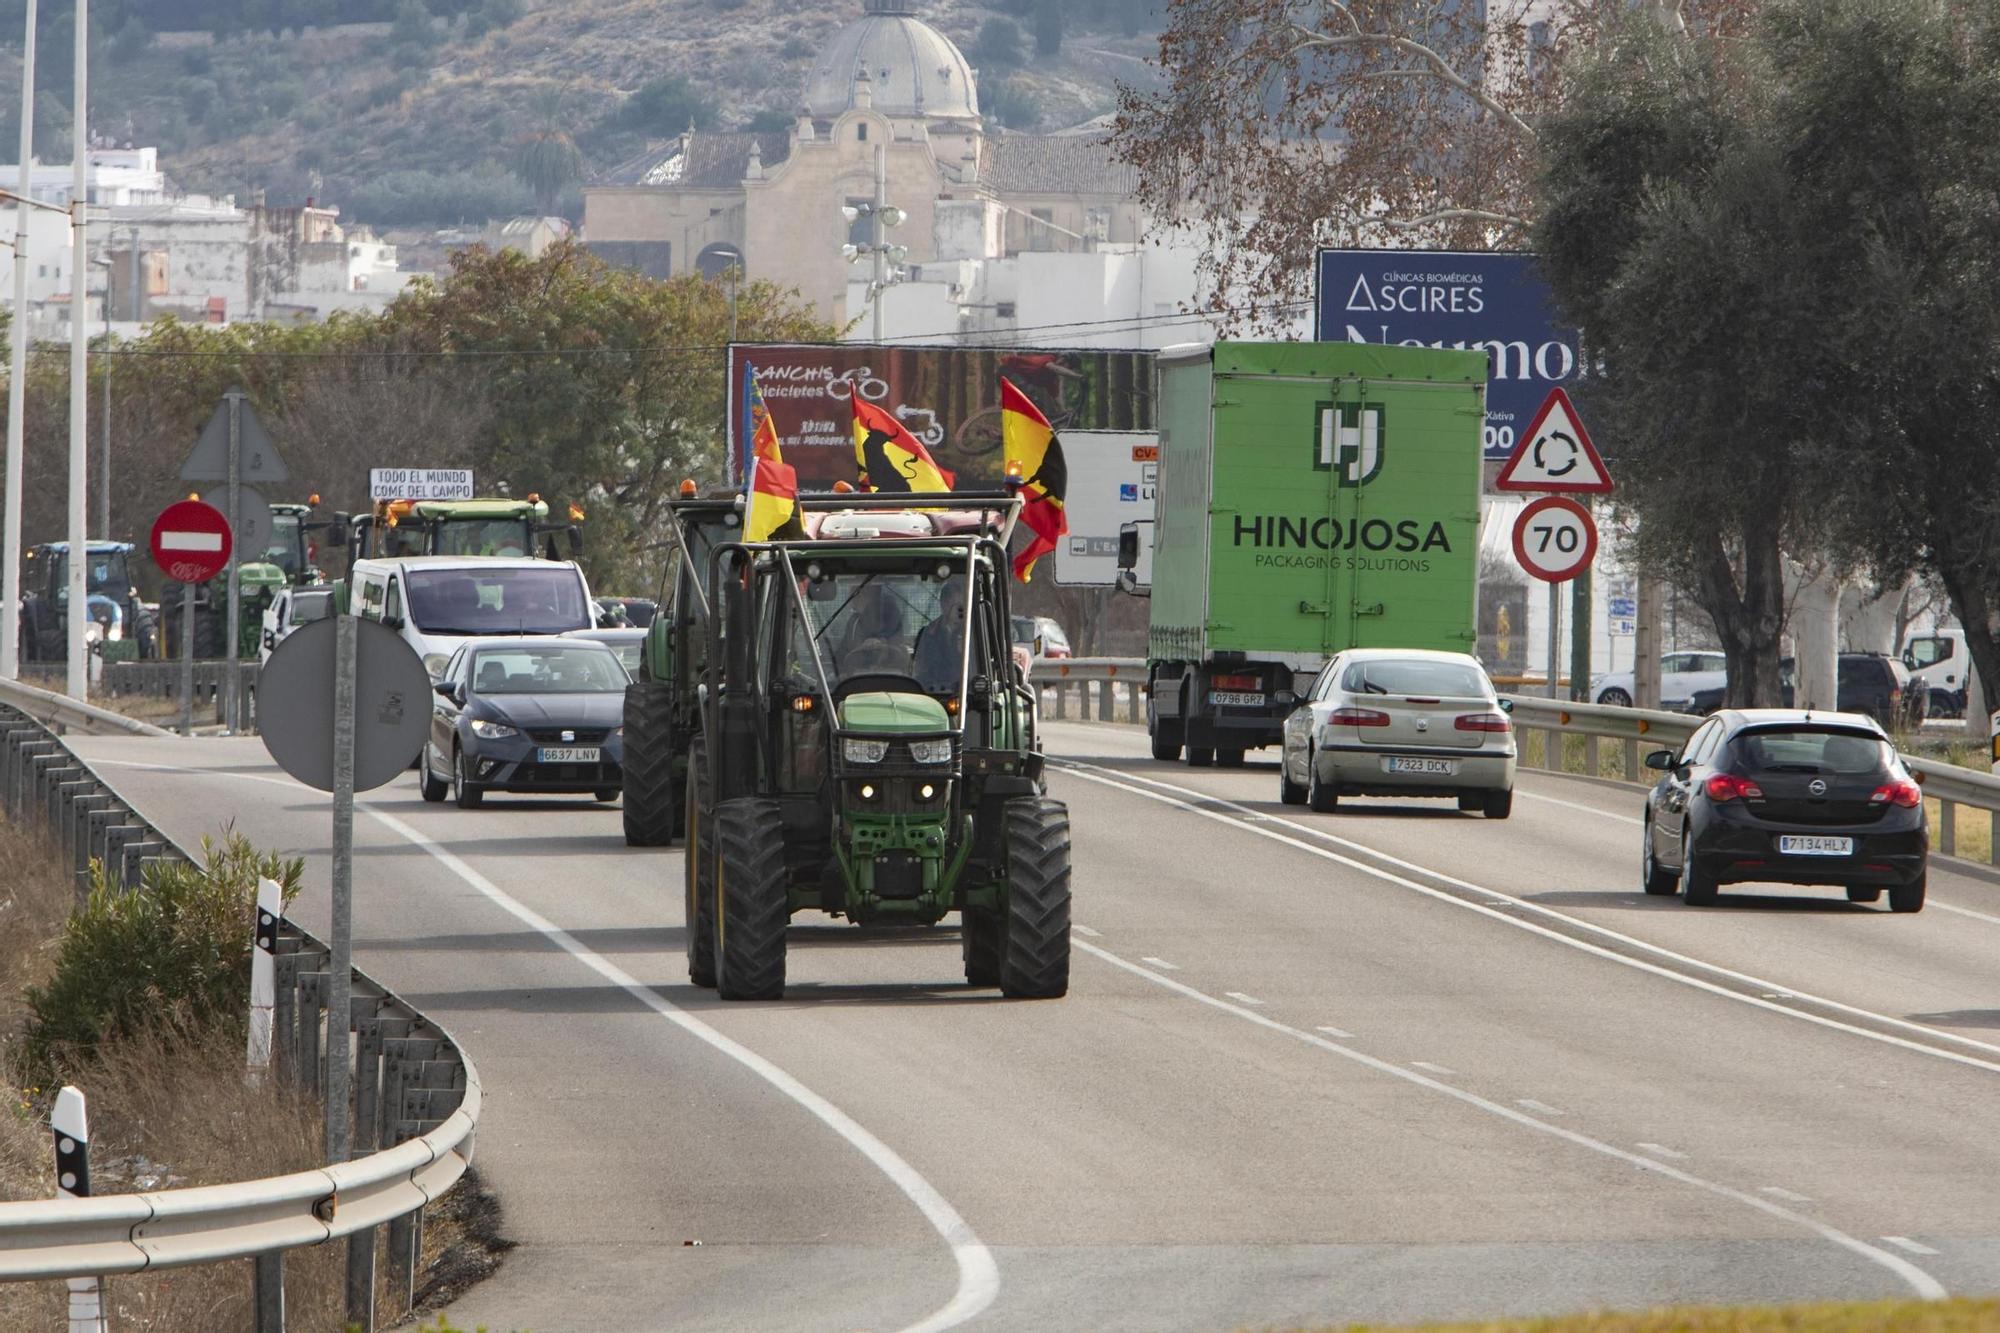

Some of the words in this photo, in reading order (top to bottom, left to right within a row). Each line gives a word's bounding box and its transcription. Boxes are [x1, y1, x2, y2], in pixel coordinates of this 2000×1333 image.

[1382, 271, 1424, 283] CLÍNICAS
[1427, 271, 1483, 284] BIOMÉDICAS
[1135, 449, 1157, 458] CV-
[379, 470, 406, 483] TODO
[410, 471, 421, 483] EL
[426, 471, 466, 483] MUNDO
[374, 485, 404, 497] COME
[407, 486, 427, 497] DEL
[432, 486, 470, 497] CAMPO
[1234, 515, 1451, 553] HINOJOSA
[1534, 526, 1578, 552] 70
[1255, 554, 1341, 569] PACKAGING
[1346, 557, 1430, 572] SOLUTIONS
[1243, 694, 1263, 705] GRZ
[544, 749, 573, 760] 6637
[576, 750, 597, 760] LNV
[1397, 759, 1423, 770] 7323
[1427, 760, 1448, 772] DCK
